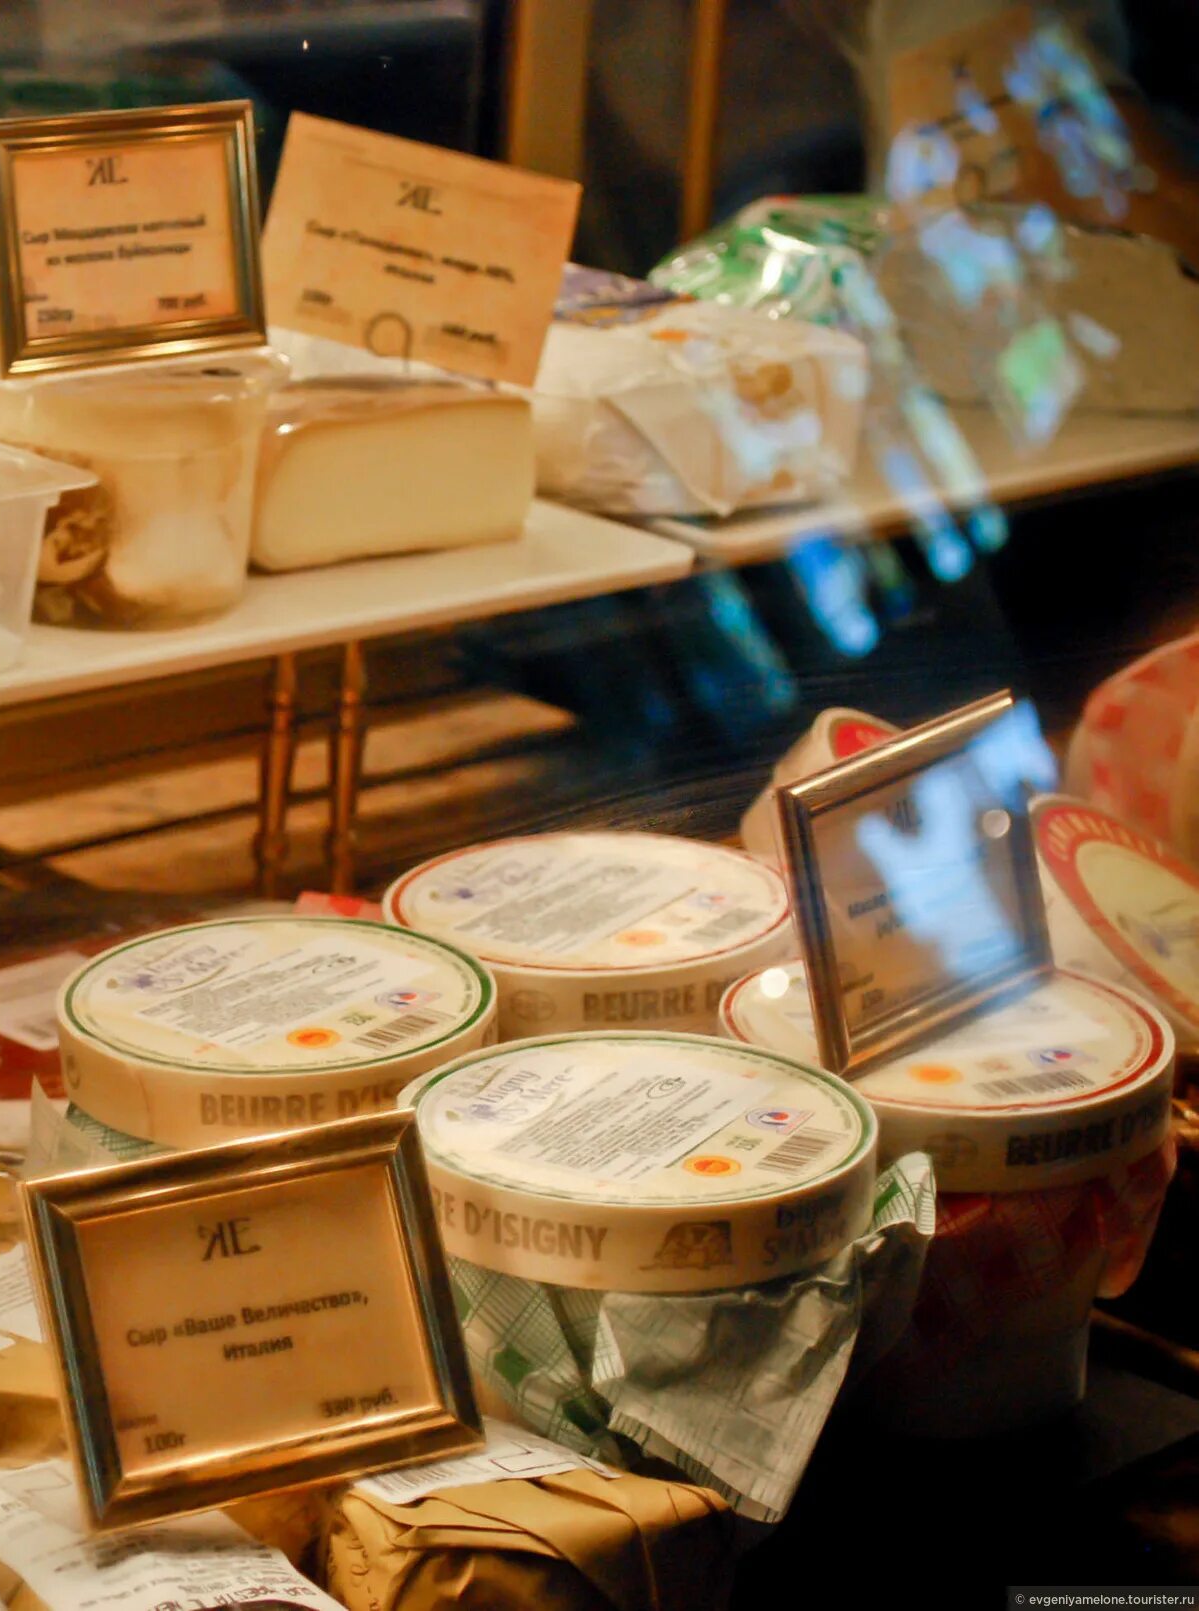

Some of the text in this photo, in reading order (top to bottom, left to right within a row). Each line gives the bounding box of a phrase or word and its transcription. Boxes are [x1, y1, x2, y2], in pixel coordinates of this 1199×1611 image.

[583, 984, 695, 1021] BEURRE
[200, 1092, 325, 1127] BEURRE
[464, 1201, 608, 1261] D'ISIGNY
[127, 1323, 166, 1347] Сыр
[173, 1314, 236, 1339] «Ваше
[222, 1336, 293, 1361] Италия
[144, 1432, 186, 1455] 100г
